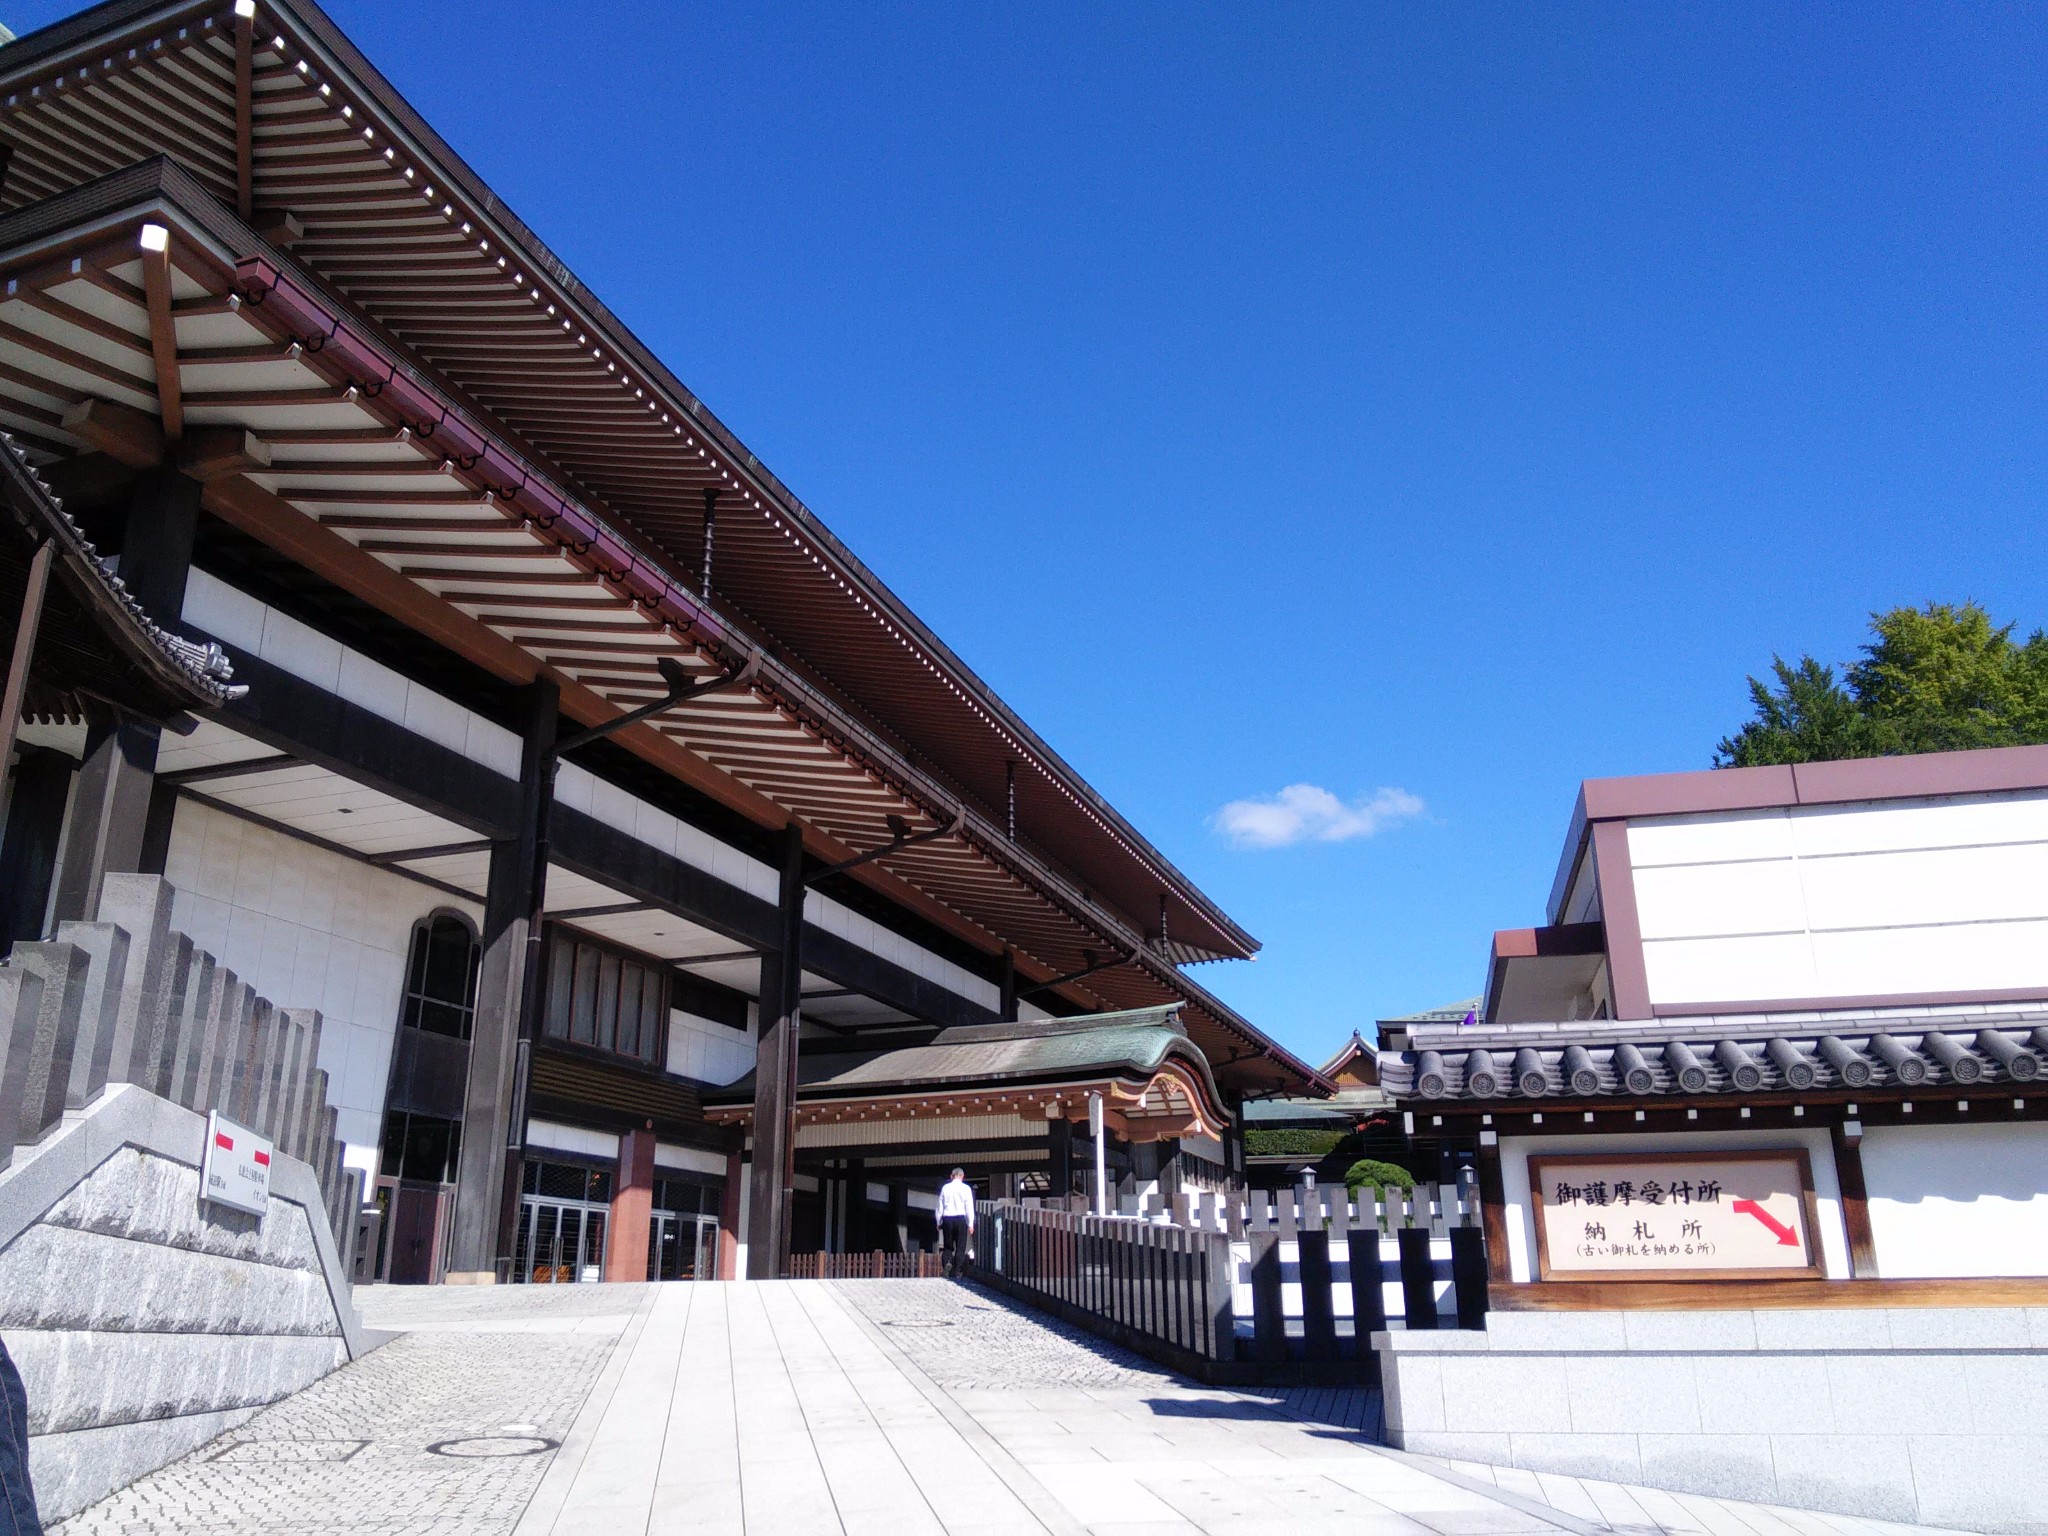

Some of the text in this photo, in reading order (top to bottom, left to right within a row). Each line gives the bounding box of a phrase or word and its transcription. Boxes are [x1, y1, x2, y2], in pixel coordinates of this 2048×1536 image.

[1556, 1180, 1722, 1207] 御護摩受付所
